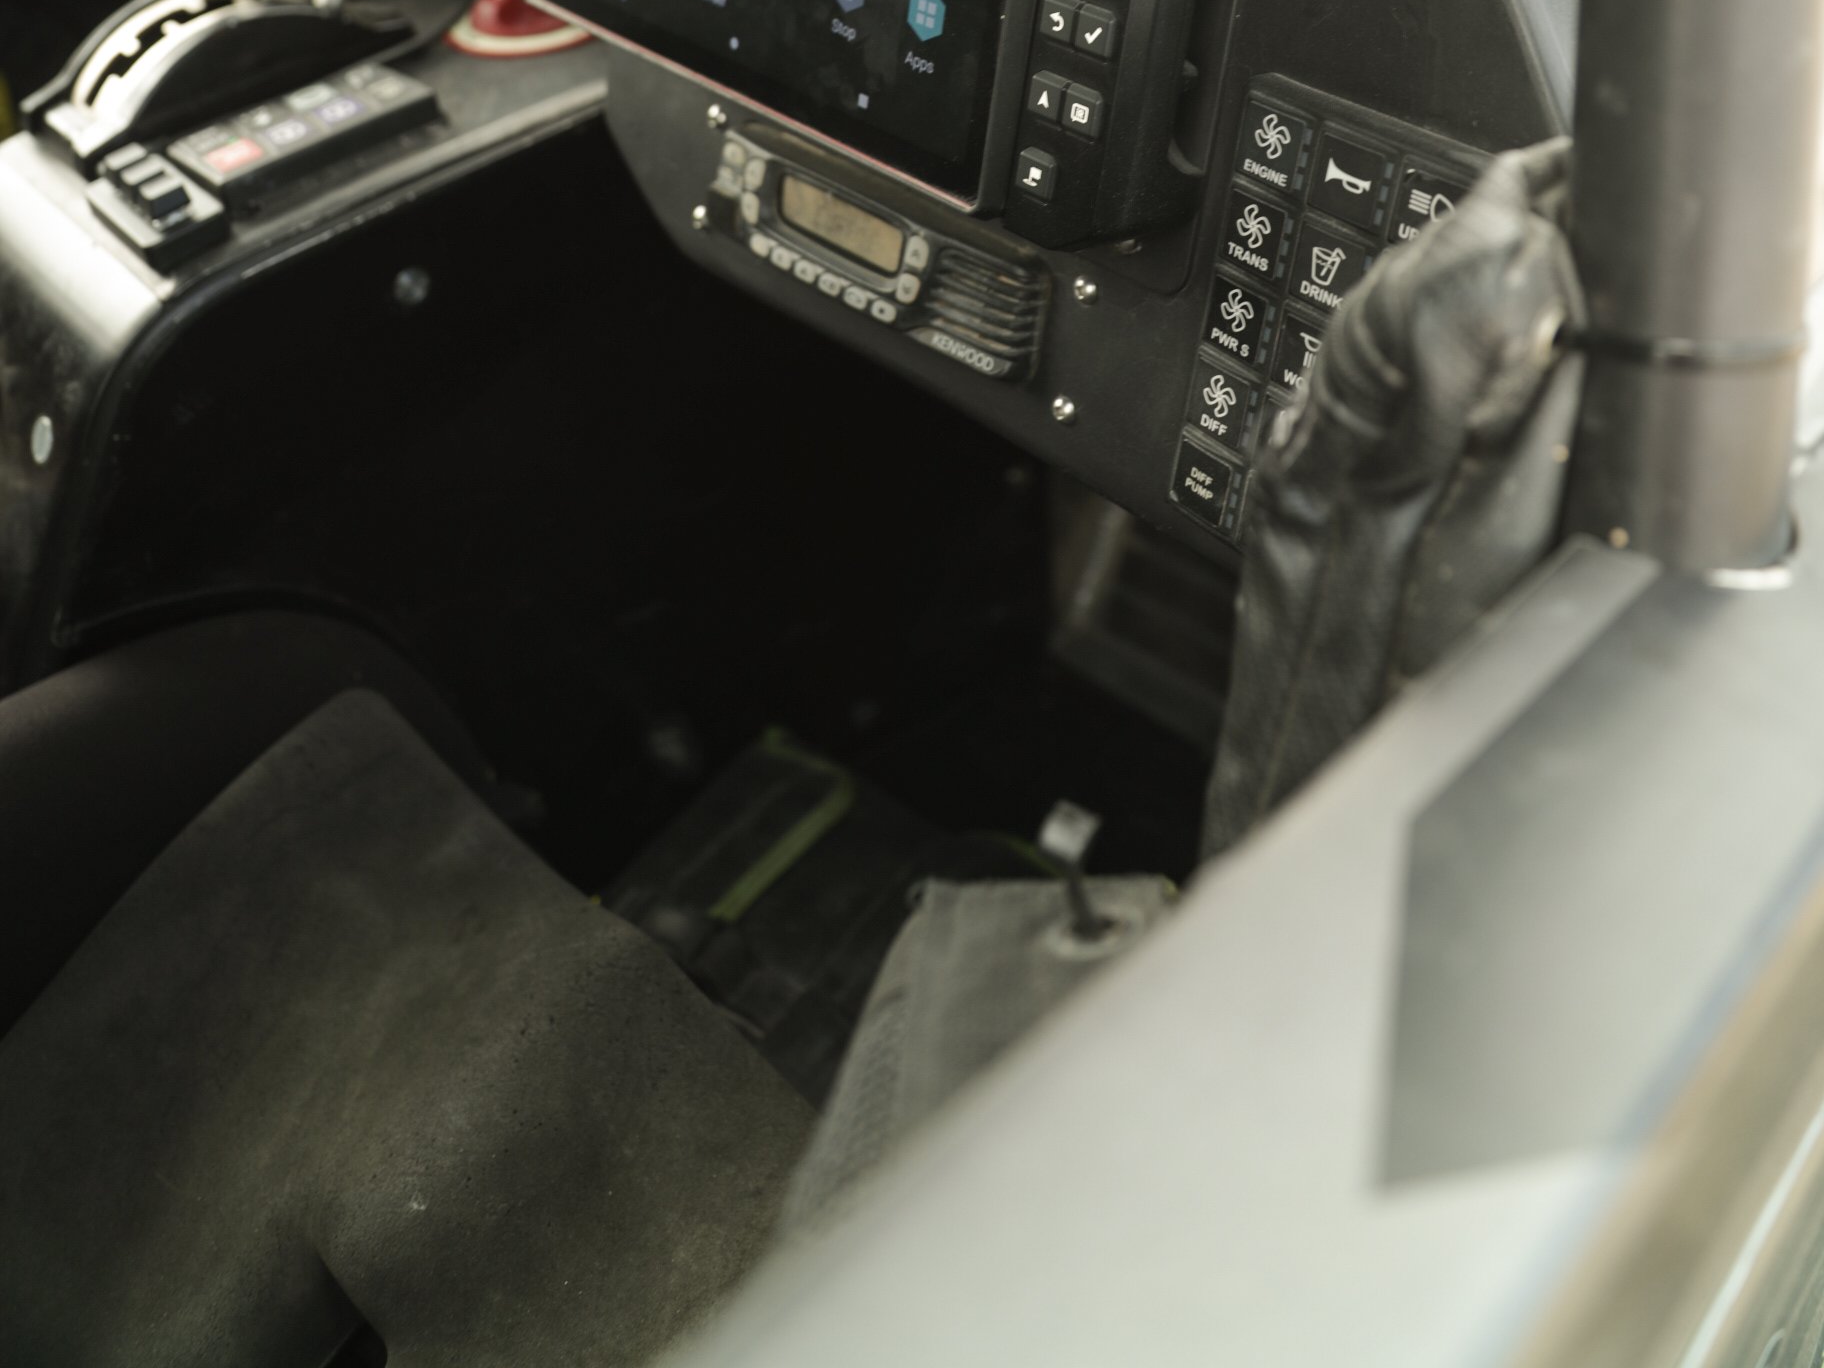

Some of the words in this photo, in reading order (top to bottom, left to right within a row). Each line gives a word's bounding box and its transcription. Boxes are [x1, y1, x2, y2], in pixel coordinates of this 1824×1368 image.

[831, 17, 857, 42] Stop
[904, 50, 935, 74] Apps
[1243, 158, 1288, 188] ENGINE
[1227, 241, 1270, 272] TRANS
[1299, 281, 1344, 310] DRINK
[931, 332, 996, 373] KENWOOD
[1211, 327, 1238, 352] PWR
[1239, 342, 1250, 358] S
[1200, 414, 1227, 436] DIFF
[1185, 477, 1213, 500] PUMP
[1190, 467, 1213, 485] DIFF
